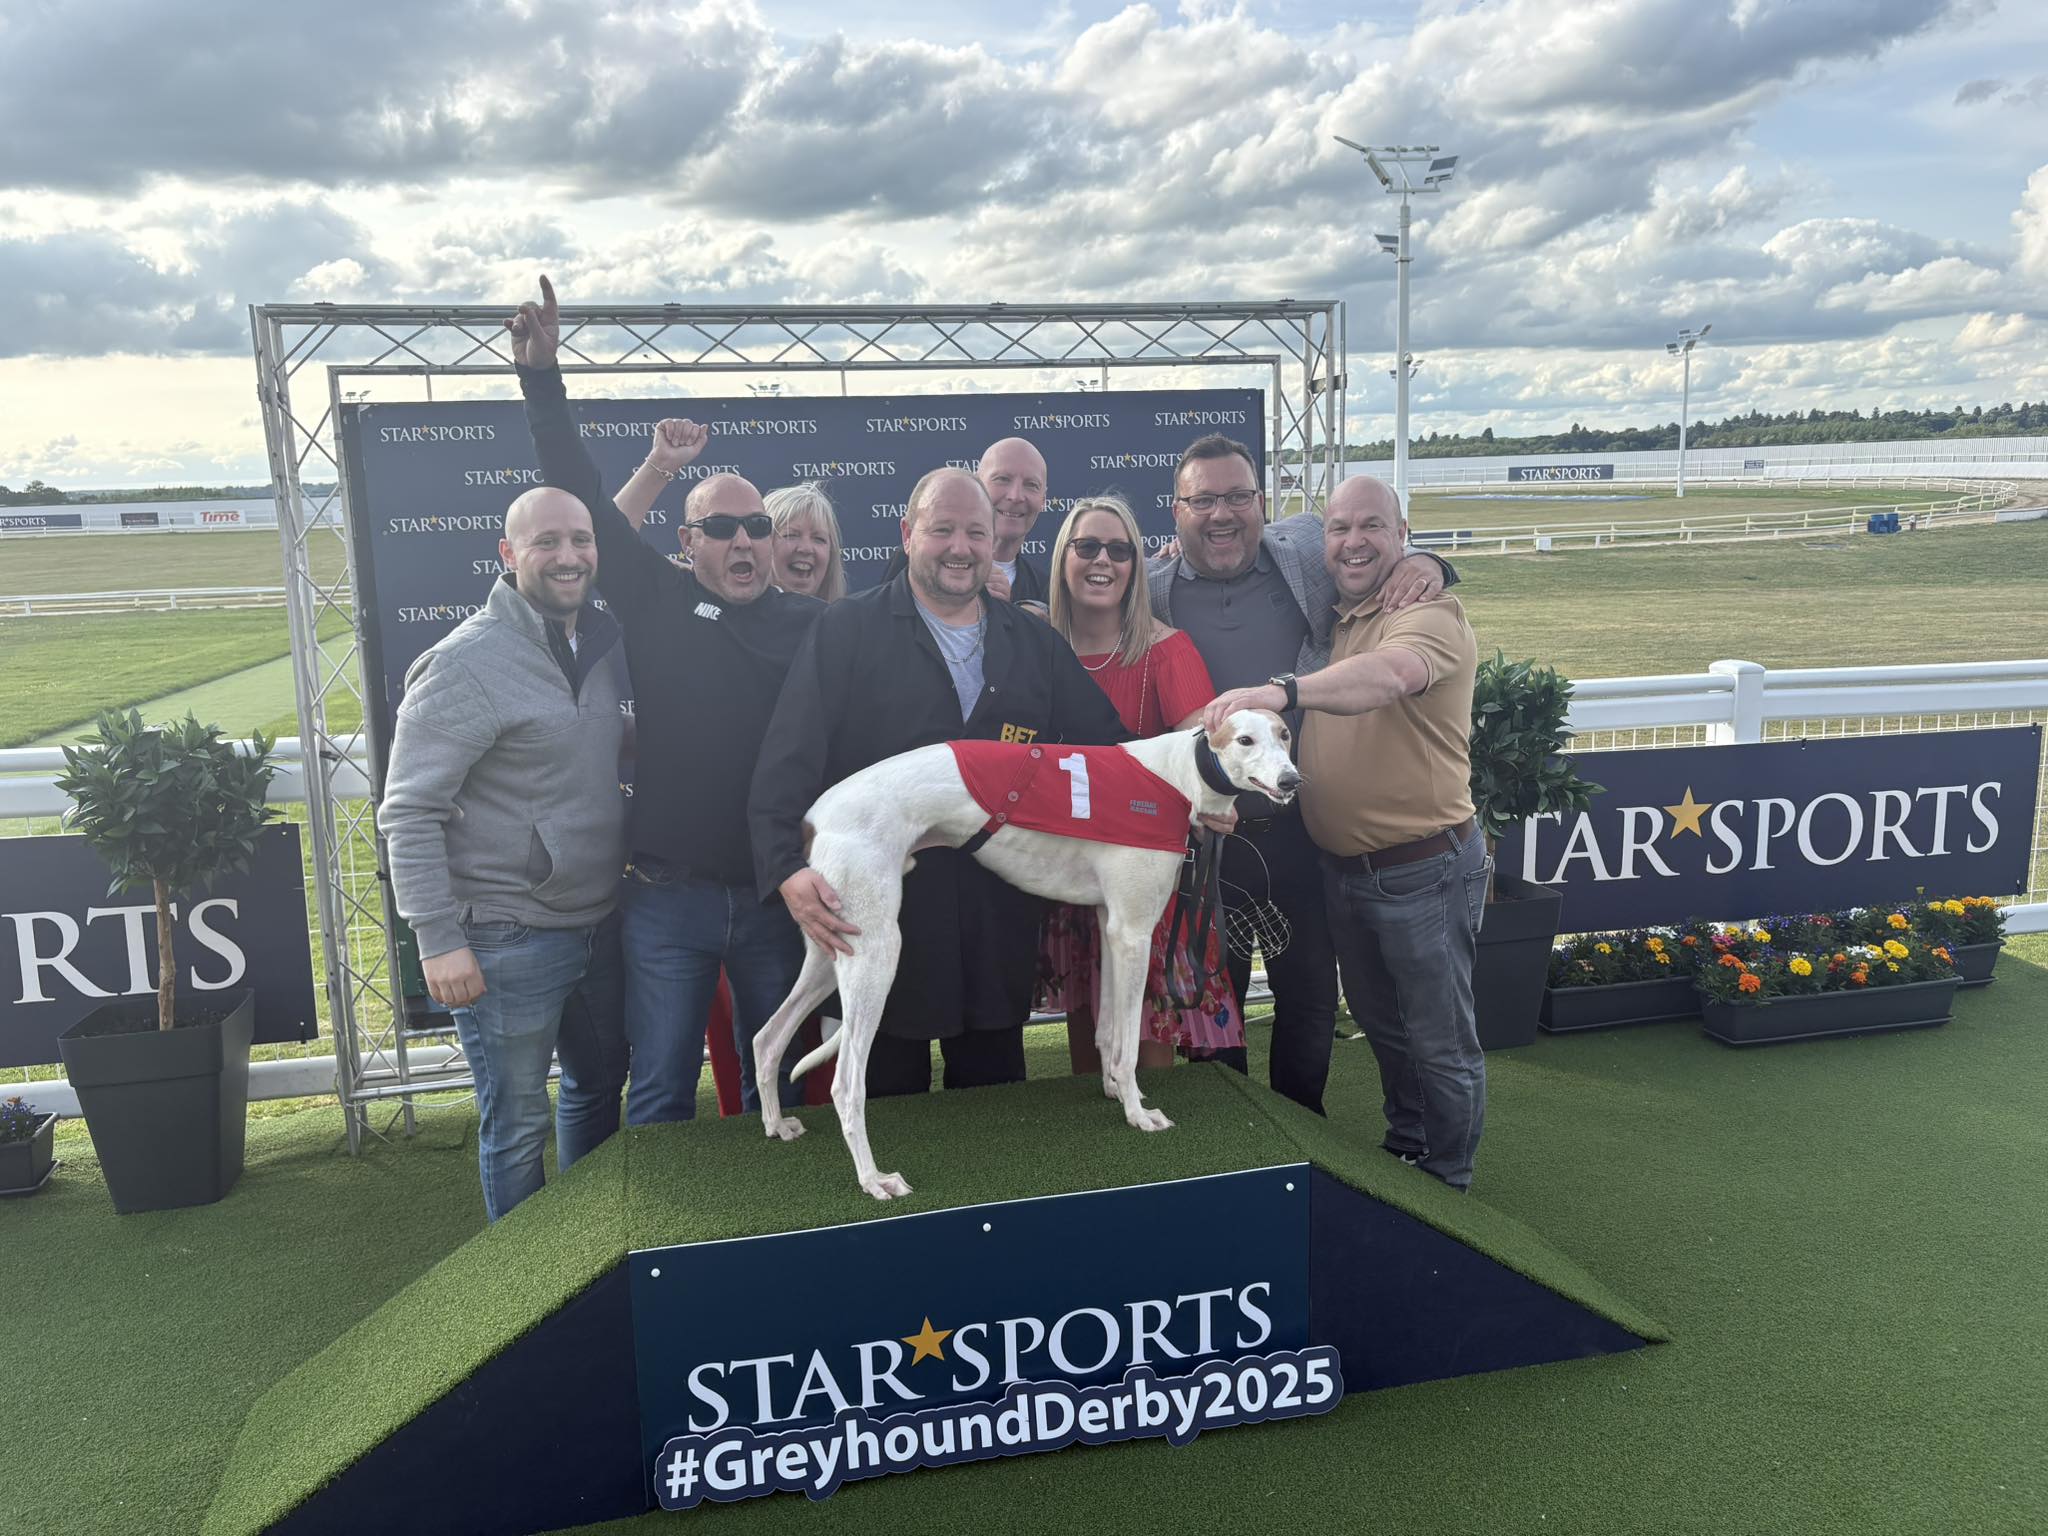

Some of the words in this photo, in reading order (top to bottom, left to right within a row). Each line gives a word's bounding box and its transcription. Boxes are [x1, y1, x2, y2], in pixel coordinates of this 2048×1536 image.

[866, 418, 905, 433] STAR
[909, 417, 967, 432] SPORTS
[1013, 416, 1052, 430] STAR
[1055, 414, 1111, 429] SPORTS
[1154, 412, 1192, 426] STAR
[1194, 410, 1246, 425] SPORTS
[380, 427, 425, 442] STAR
[429, 425, 495, 441] SPORTS
[711, 421, 754, 436] STAR
[756, 420, 818, 435] SPORTS
[792, 463, 834, 478] STAR
[836, 461, 896, 476] SPORTS
[1090, 455, 1127, 470] STAR
[1130, 453, 1184, 468] SPORTS
[464, 471, 509, 486] STAR
[512, 469, 545, 484] SPO
[1520, 468, 1551, 481] STAR
[1554, 467, 1601, 480] SPORTS
[1156, 494, 1173, 508] ST
[871, 504, 908, 518] STAR
[8, 516, 47, 527] SPORTS
[390, 518, 434, 534] STAR
[438, 515, 503, 531] SPORTS
[1020, 540, 1046, 554] RTS
[398, 606, 441, 622] STAR
[694, 601, 723, 621] NIKE
[1000, 722, 1038, 744] BET
[1059, 753, 1090, 819] 1
[1522, 806, 1680, 885] TAR
[1706, 781, 2001, 875] SPORTS
[0, 898, 246, 1004] RTS
[687, 1339, 926, 1433] STAR
[951, 1281, 1272, 1385] SPORTS
[665, 1357, 1334, 1499] #GreyhoundDerby2025
